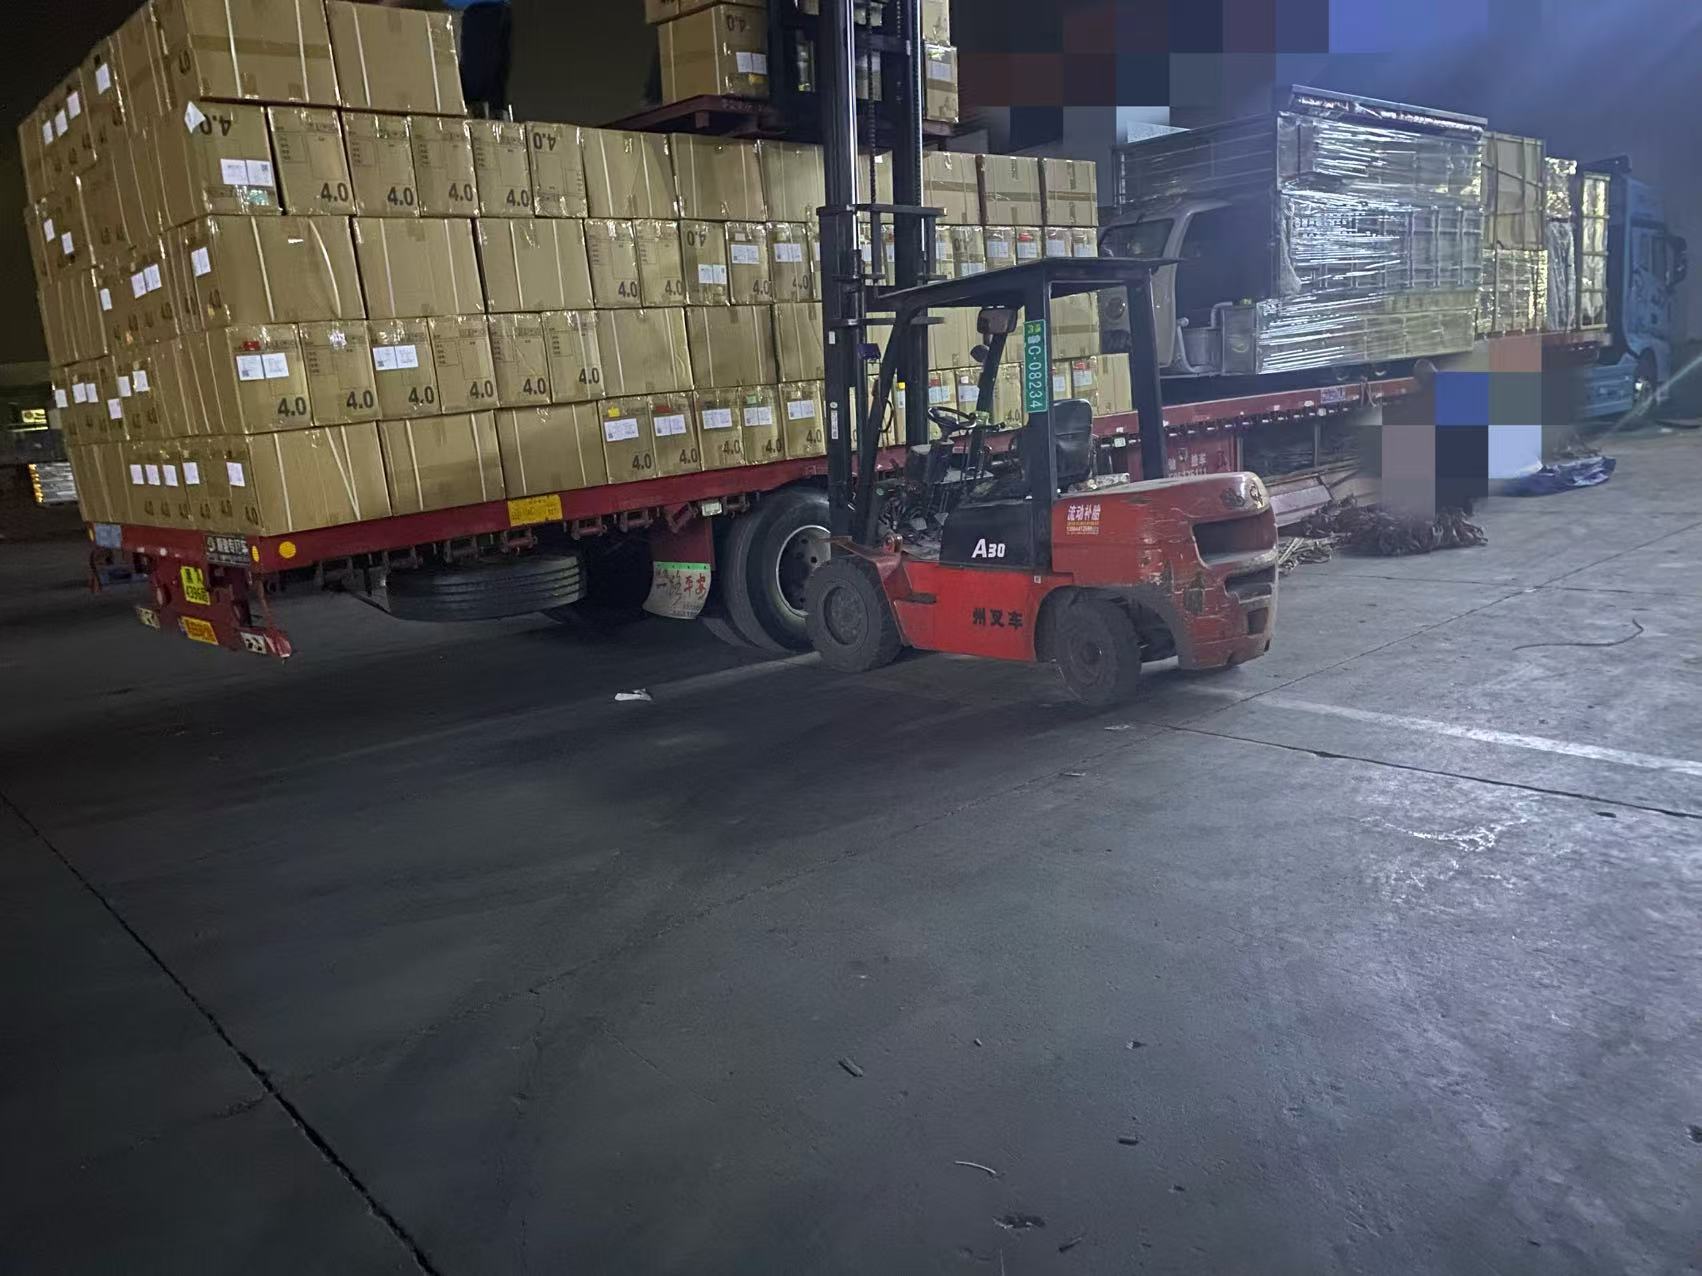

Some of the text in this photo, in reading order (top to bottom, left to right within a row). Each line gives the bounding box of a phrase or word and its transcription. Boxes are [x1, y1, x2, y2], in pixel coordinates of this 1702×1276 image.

[533, 132, 557, 151] 4.0
[320, 182, 349, 202] 4.0
[387, 186, 414, 206] 4.0
[448, 182, 474, 202] 4.0
[506, 189, 530, 207] 4.0
[618, 281, 638, 298] 4.0
[665, 280, 683, 296] 4.0
[752, 279, 770, 295] 4.0
[579, 367, 600, 385] 4.0
[408, 385, 435, 405] 4.0
[469, 380, 494, 399] 4.0
[523, 377, 547, 396] 4.0
[277, 396, 307, 417] 4.0
[346, 390, 374, 410] 4.0
[806, 428, 822, 444] 4.0
[723, 439, 741, 455] 4.0
[765, 438, 782, 454] 4.0
[632, 453, 652, 471] 4.0
[679, 447, 698, 465] 4.0
[971, 538, 1006, 558] A30
